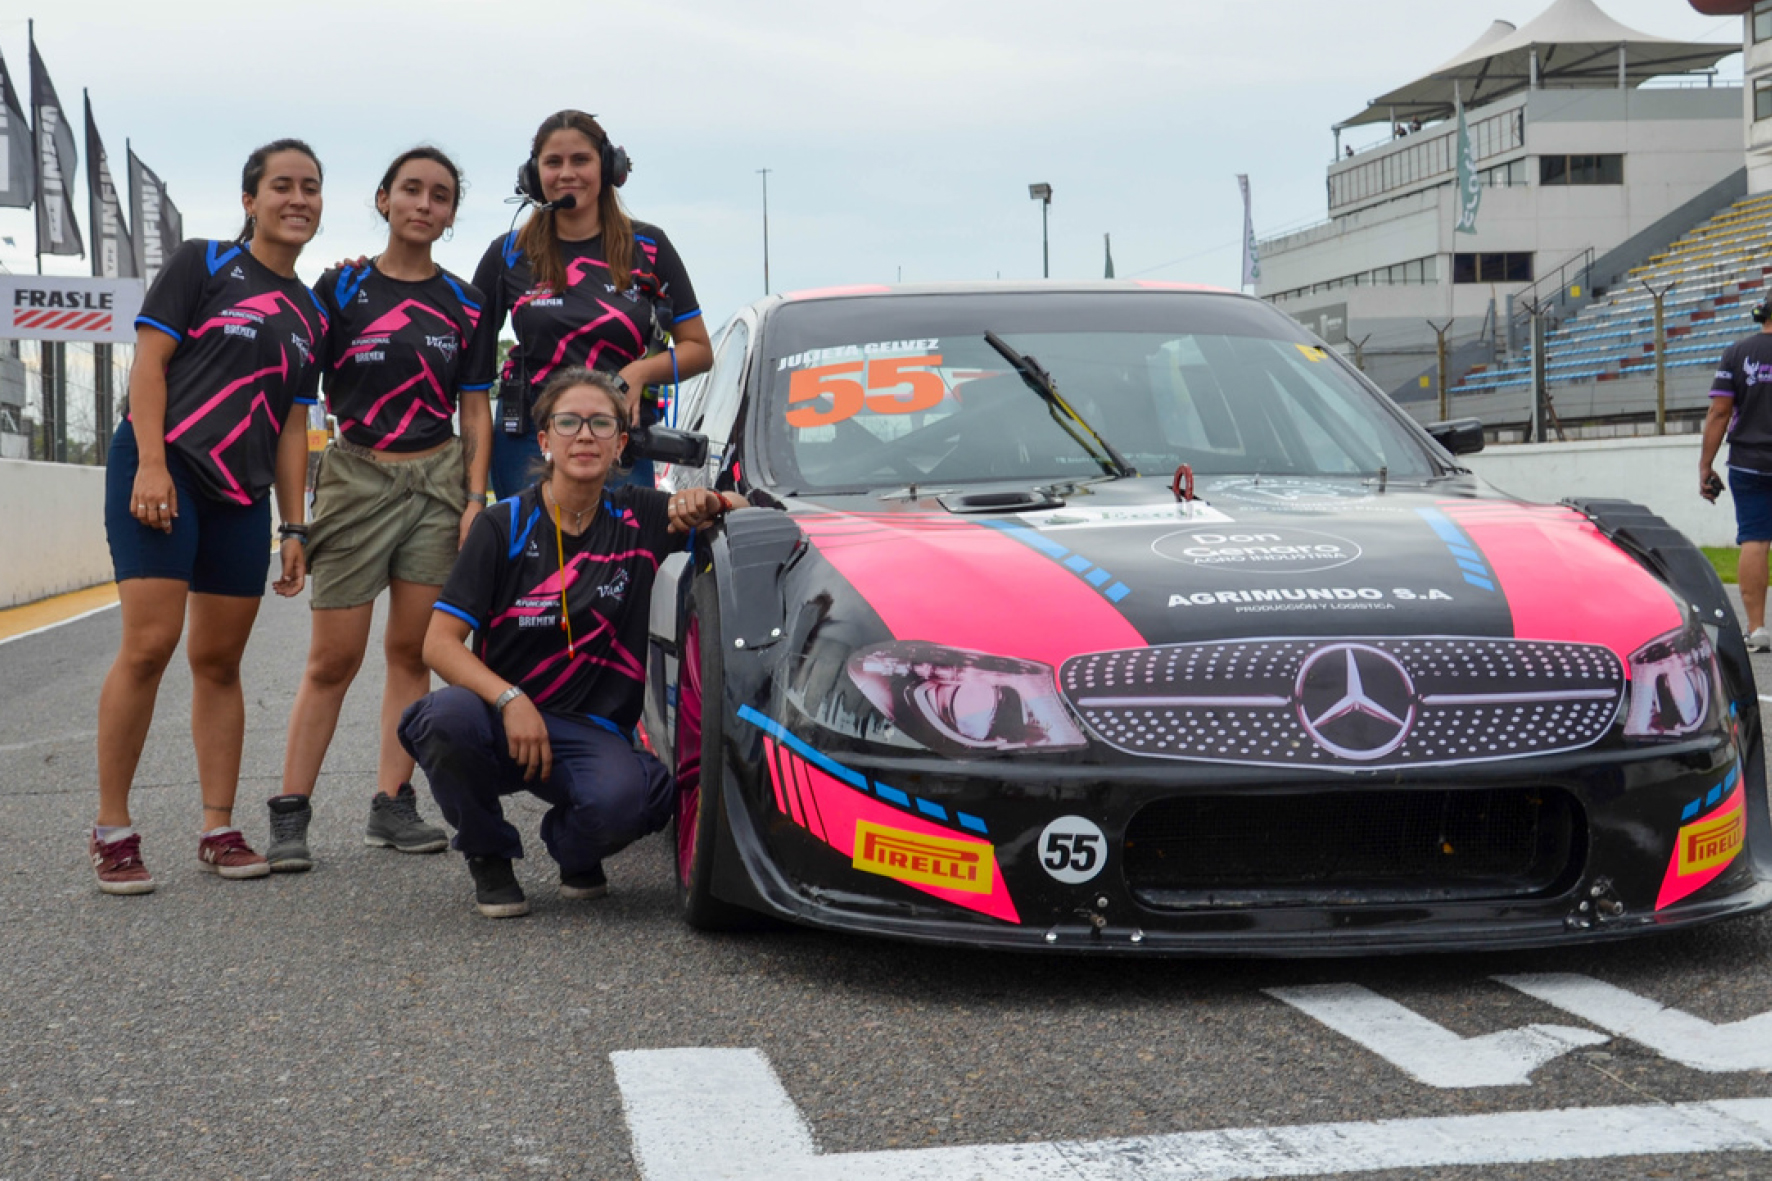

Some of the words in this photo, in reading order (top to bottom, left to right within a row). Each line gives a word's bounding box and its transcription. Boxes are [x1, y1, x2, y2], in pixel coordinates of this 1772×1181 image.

[863, 338, 939, 354] GELVEZ
[785, 355, 945, 428] 55
[1183, 544, 1341, 557] Genaro
[1191, 533, 1282, 544] Don
[1168, 588, 1383, 607] AGRIMUNDO
[1044, 834, 1100, 872] 55
[1687, 815, 1742, 864] PIRELLI
[863, 831, 980, 882] PIRELLI
